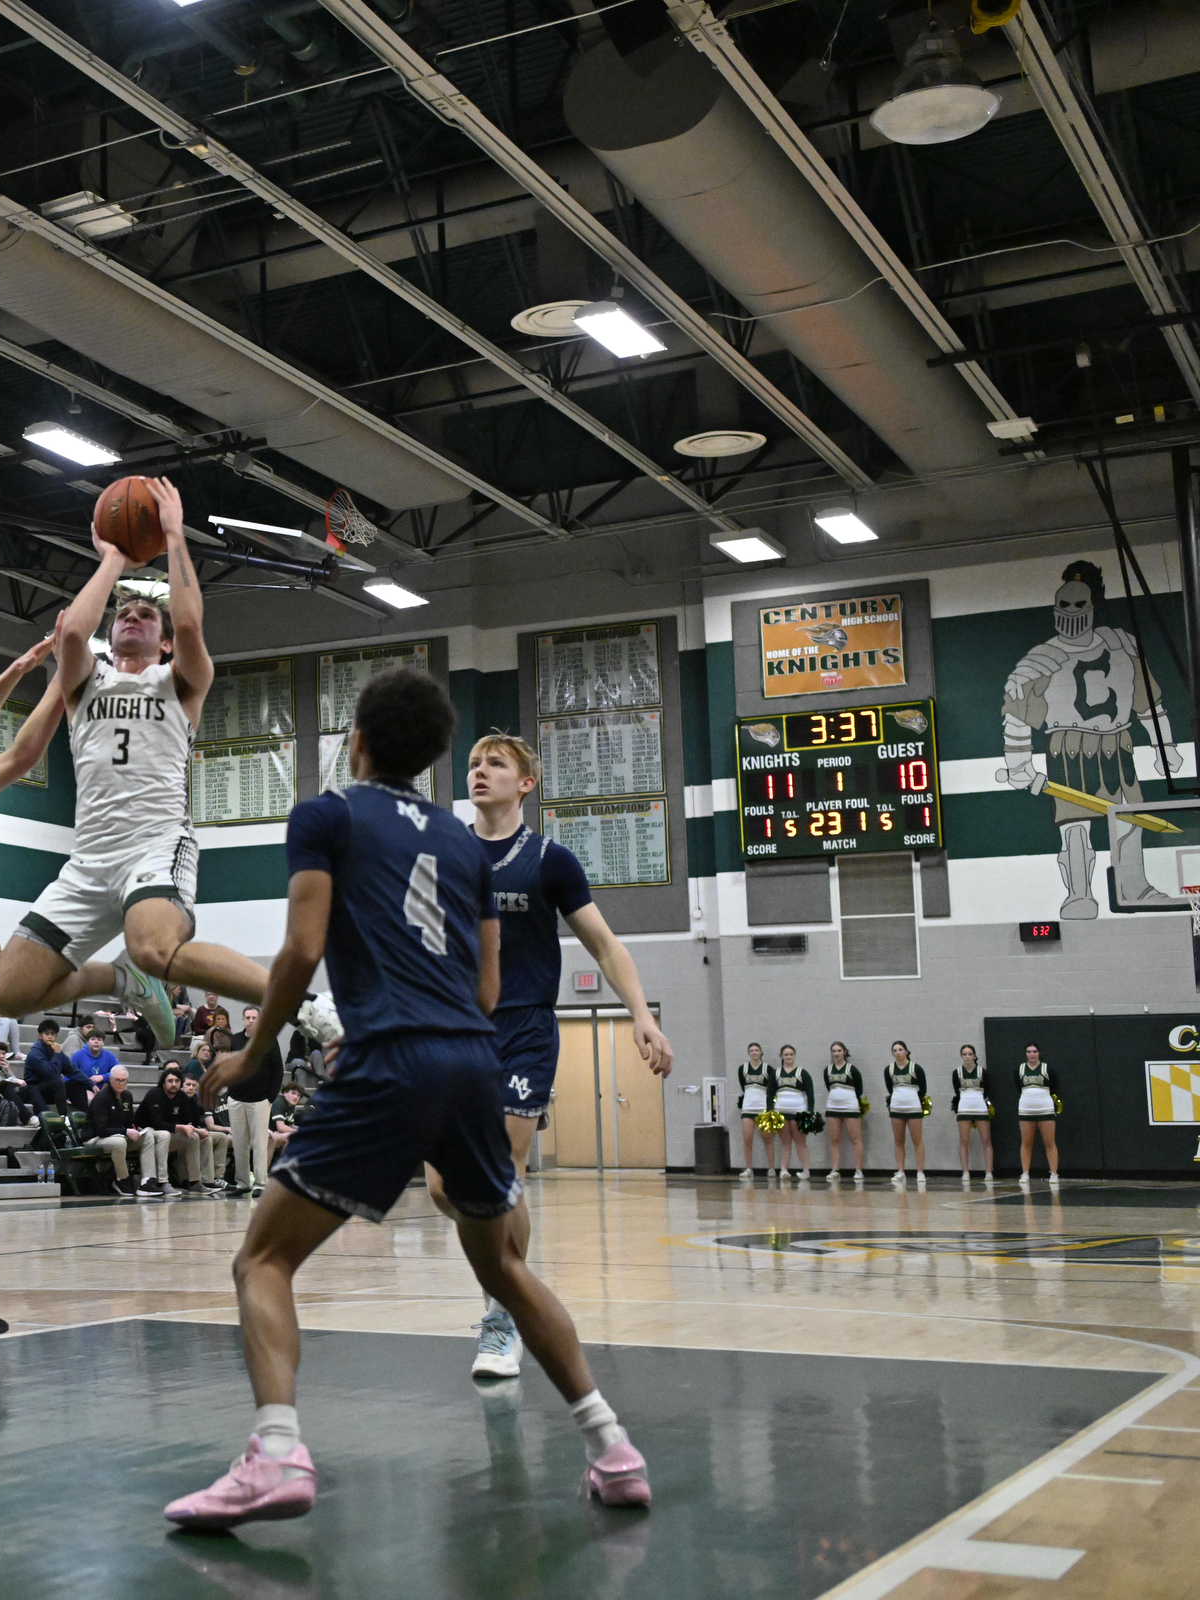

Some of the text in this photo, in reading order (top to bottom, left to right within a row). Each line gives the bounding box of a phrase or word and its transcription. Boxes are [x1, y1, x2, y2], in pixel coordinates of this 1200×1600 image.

[763, 598, 898, 625] CENTURY
[841, 613, 899, 627] HIGH SCHOOL
[766, 646, 819, 659] HOME OF THE
[767, 647, 900, 676] KNIGHTS
[87, 697, 165, 721] KNIGHTS
[811, 711, 877, 744] 3:37
[112, 728, 130, 765] 3
[231, 743, 280, 756] CHAMPIONS
[877, 742, 924, 759] GUEST
[742, 752, 800, 770] KNIGHTS
[817, 756, 851, 768] PERIOD
[837, 772, 843, 791] 1
[899, 761, 928, 790] 10
[806, 798, 870, 811] PLAYER FOUL
[902, 794, 933, 805] FOULS
[590, 802, 651, 816] CHAMPIONS
[745, 805, 774, 816] FOULS
[781, 811, 799, 819] T.O.L.
[876, 804, 895, 812] T.O.L.
[924, 807, 930, 827] 1
[765, 818, 772, 838] 1
[823, 839, 856, 850] MATCH
[904, 834, 935, 845] SCORE
[747, 844, 777, 855] SCORE
[403, 852, 449, 956] 4
[578, 974, 594, 987] EXIT
[1168, 1025, 1200, 1052] C
